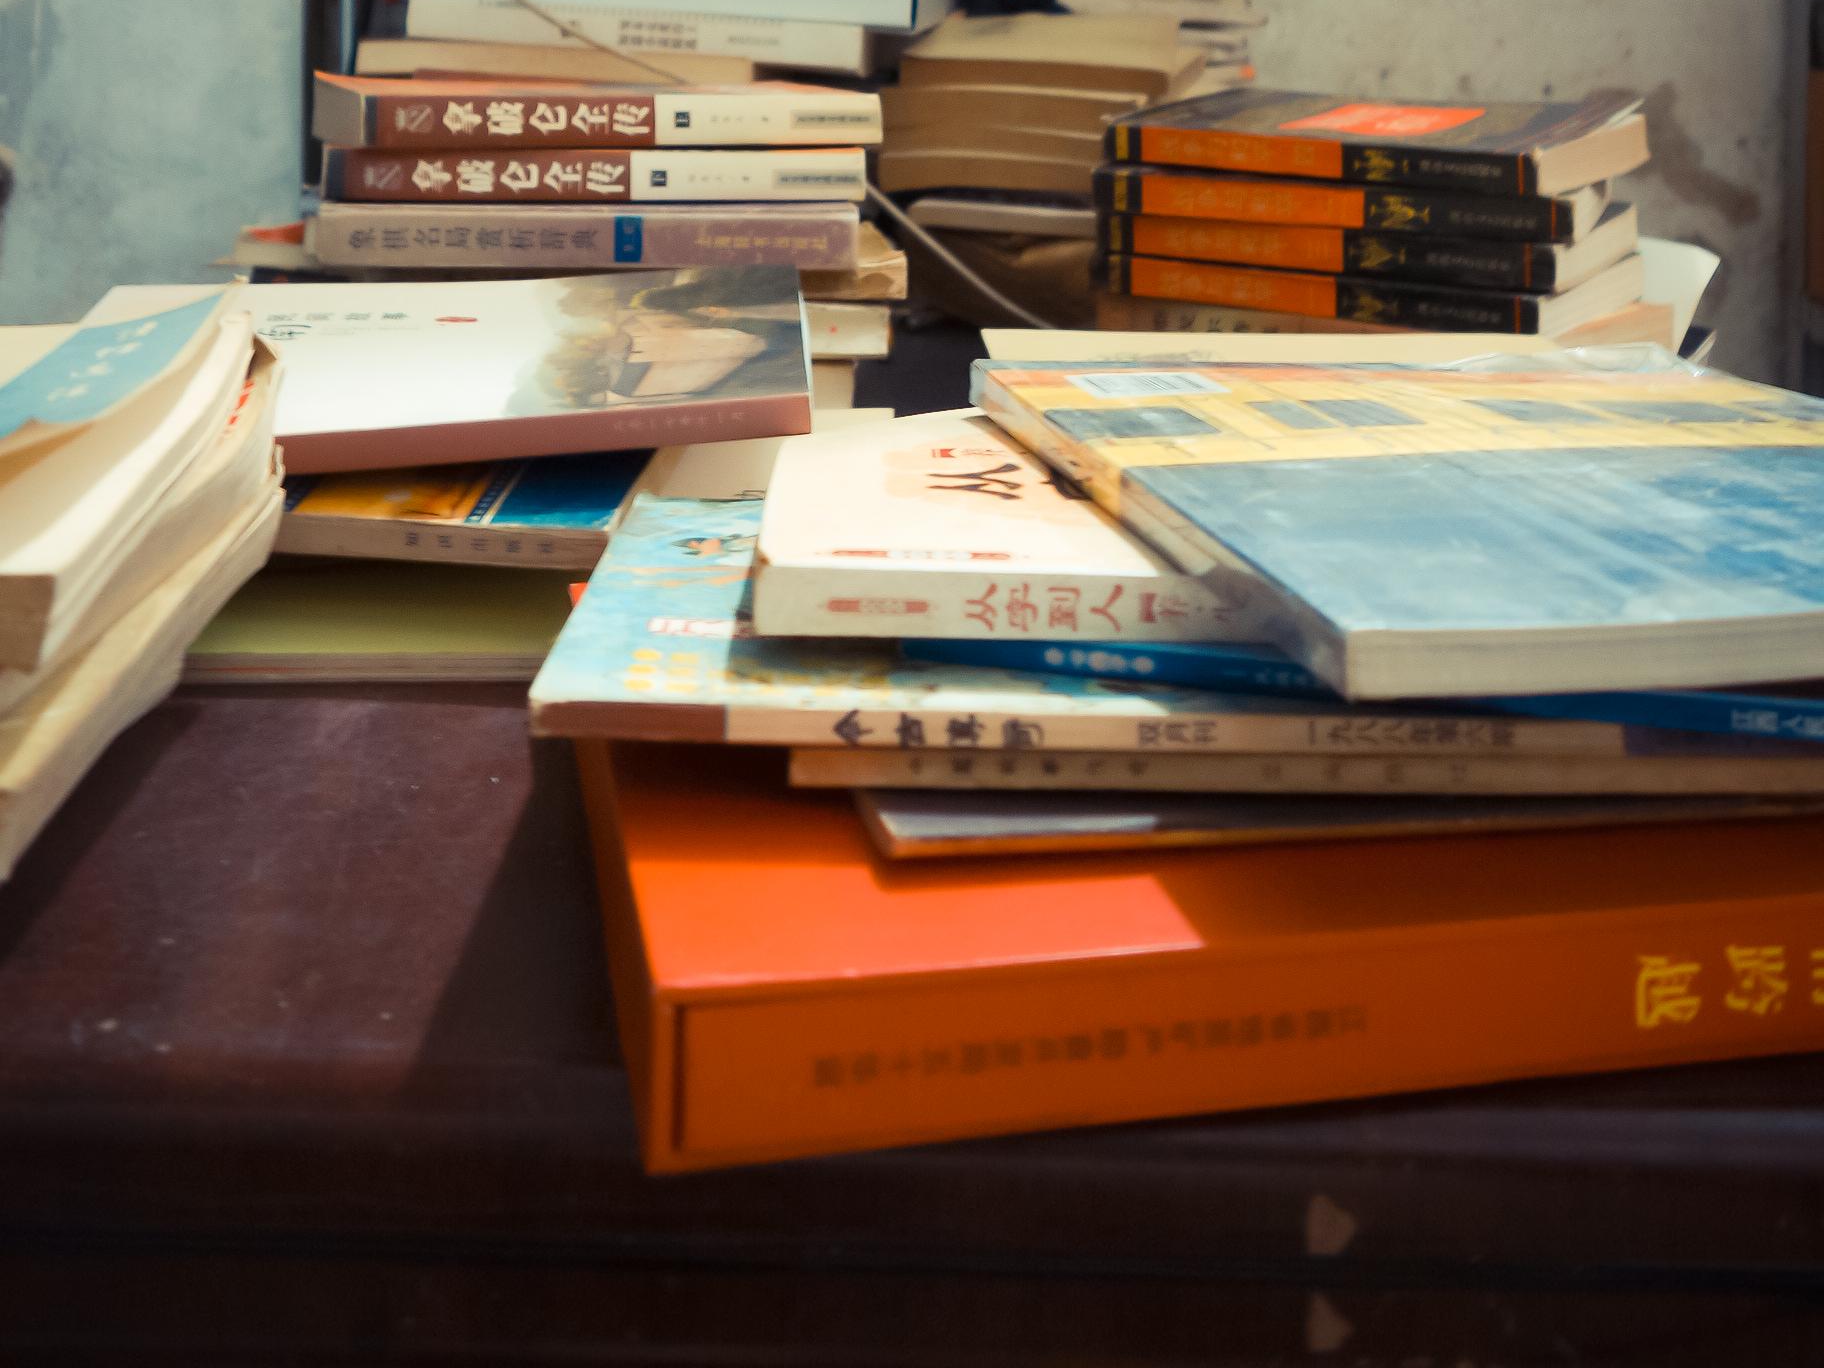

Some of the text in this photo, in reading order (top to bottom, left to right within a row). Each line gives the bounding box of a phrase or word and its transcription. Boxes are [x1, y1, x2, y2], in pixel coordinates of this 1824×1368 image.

[442, 100, 651, 135] 拿破仑全传
[411, 158, 625, 194] 拿破仑全传
[964, 582, 1125, 632] 从字到人
